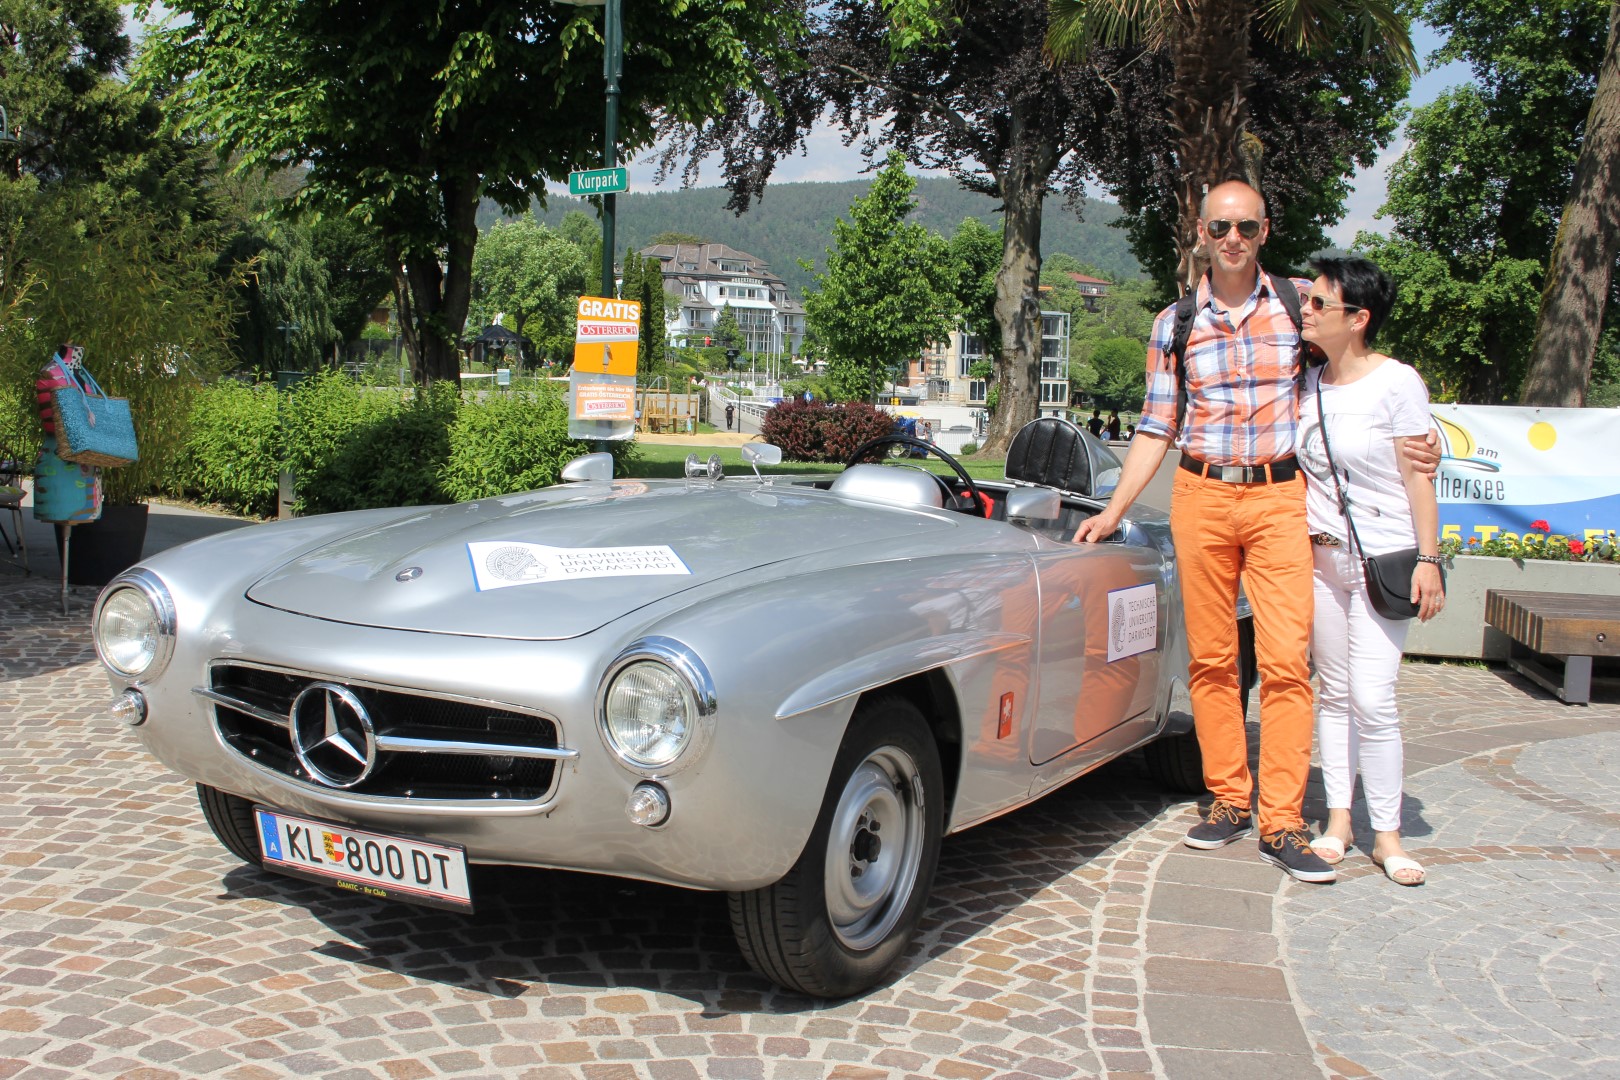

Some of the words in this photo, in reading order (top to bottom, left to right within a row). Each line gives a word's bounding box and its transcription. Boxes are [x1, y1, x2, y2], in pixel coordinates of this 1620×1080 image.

[578, 170, 619, 191] Kurpark
[579, 299, 639, 320] GRATIS
[581, 325, 637, 335] ÖSTERREICH
[1477, 447, 1498, 459] am
[565, 562, 677, 573] DARMSTADT
[270, 841, 278, 852] A
[286, 823, 323, 863] KL
[345, 836, 404, 880] 800
[411, 848, 450, 890] DT
[337, 880, 359, 891] ÖAMTC
[373, 888, 387, 897] Club
